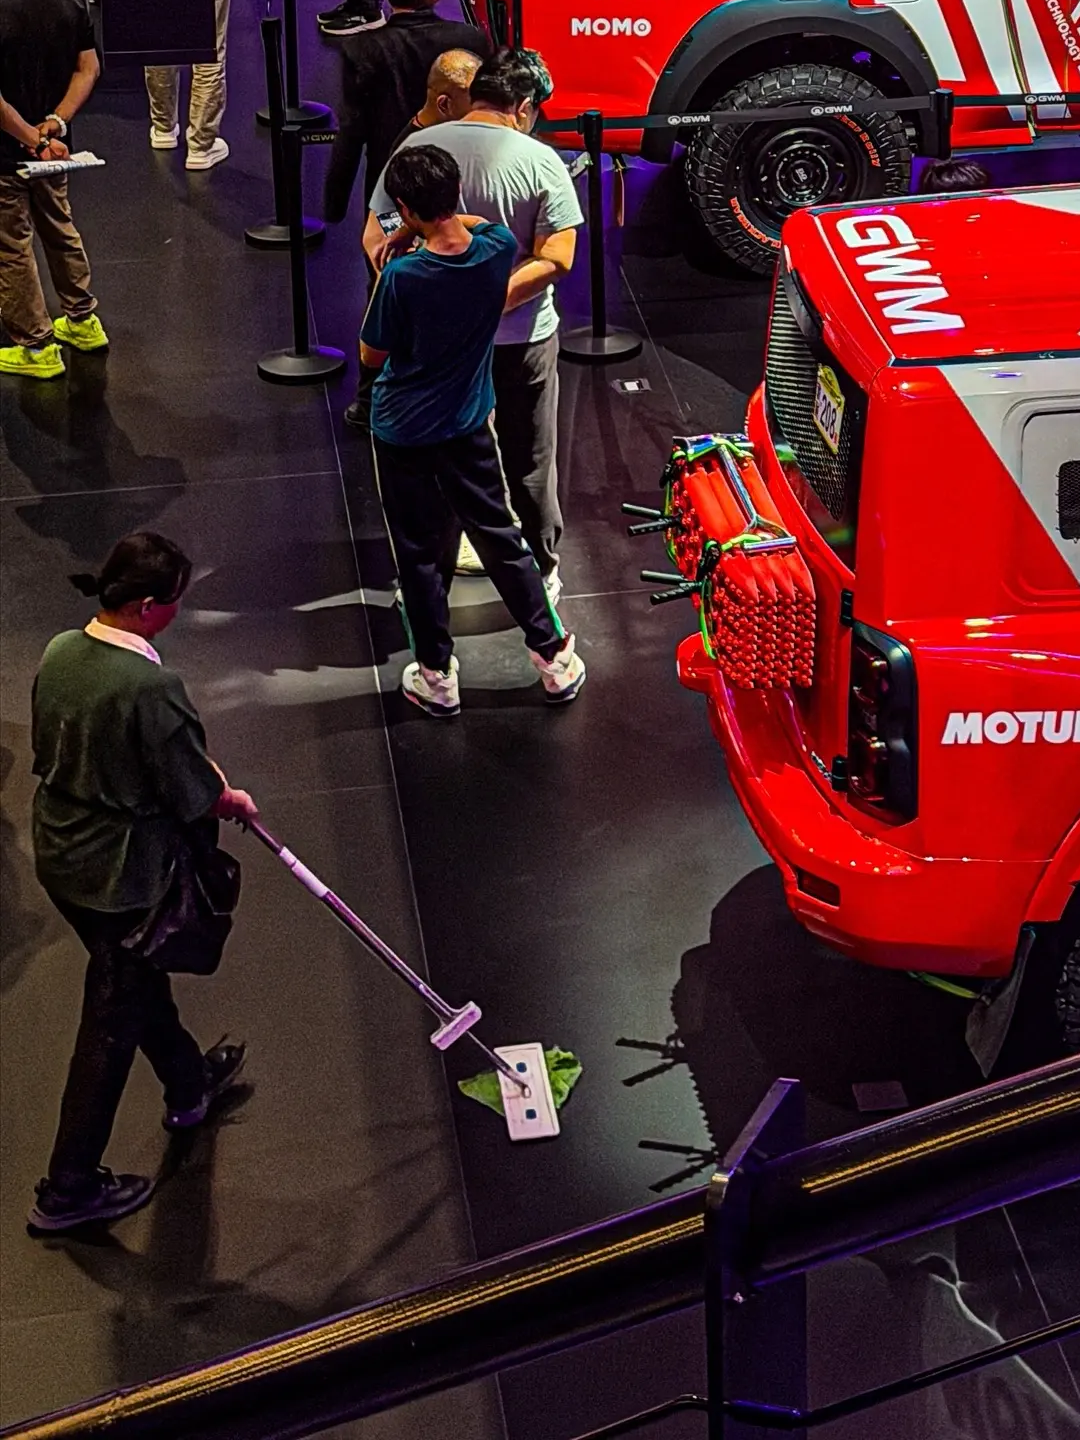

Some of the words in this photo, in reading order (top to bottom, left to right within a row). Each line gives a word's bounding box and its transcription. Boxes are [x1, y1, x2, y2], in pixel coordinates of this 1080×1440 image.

[571, 18, 652, 36] MOMO
[1038, 94, 1066, 102] GWM
[825, 104, 853, 114] GWM
[682, 114, 711, 124] GWM
[836, 214, 966, 336] GWM
[820, 394, 837, 440] 208
